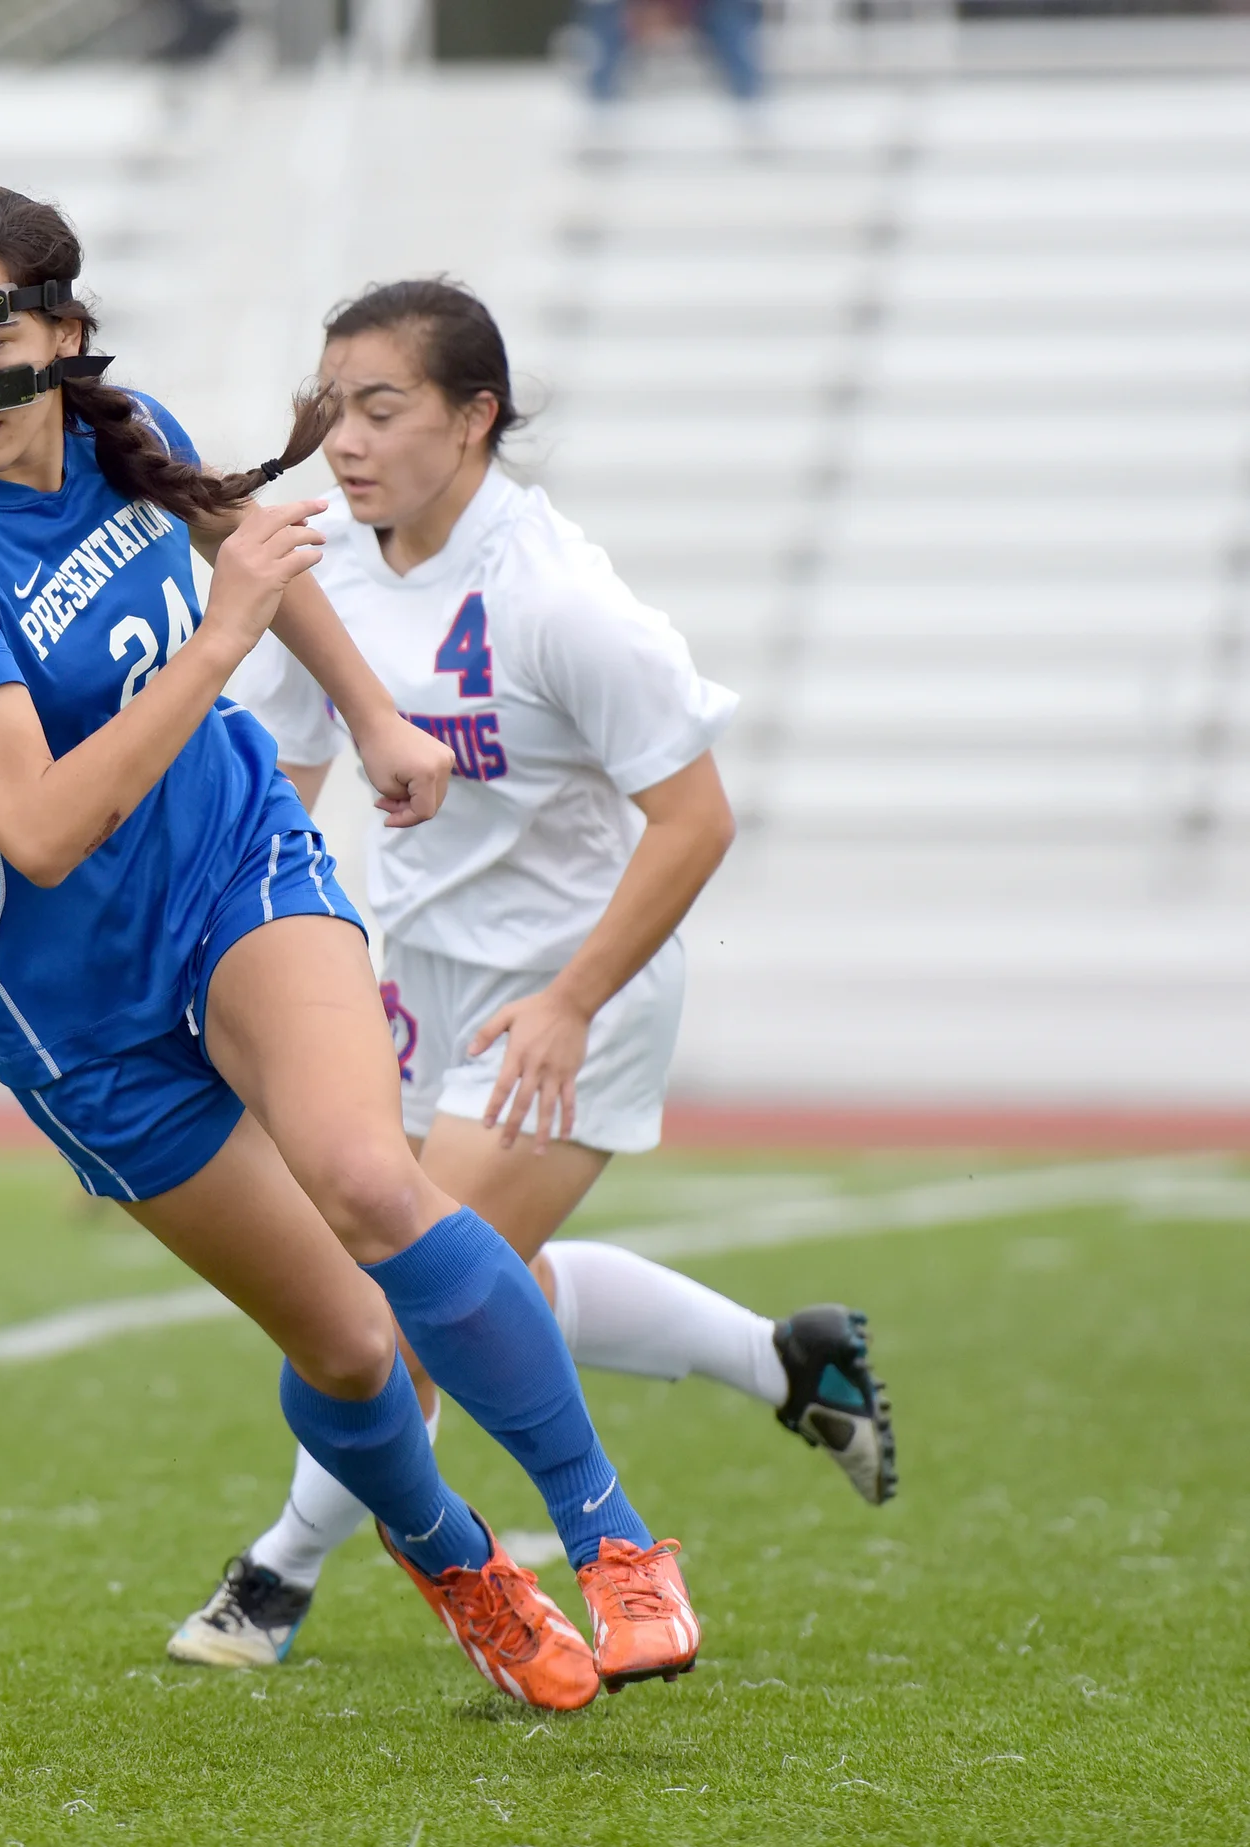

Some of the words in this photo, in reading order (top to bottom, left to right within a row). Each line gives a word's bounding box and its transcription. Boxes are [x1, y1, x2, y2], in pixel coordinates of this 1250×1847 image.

[19, 499, 174, 661] PRESENTATION
[109, 577, 194, 712] 24
[434, 591, 493, 698] 4
